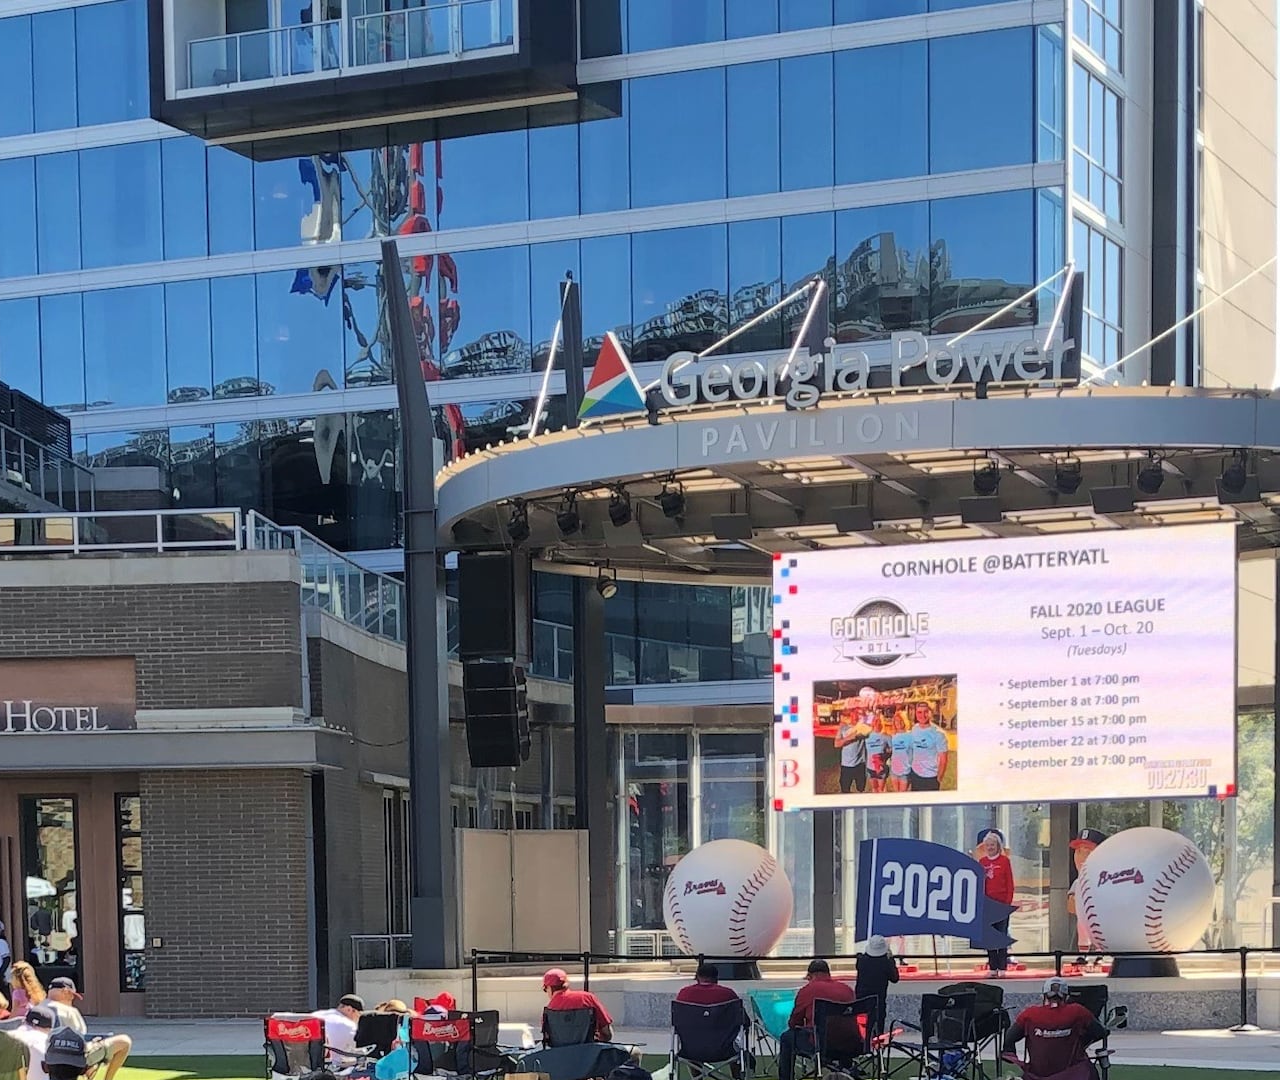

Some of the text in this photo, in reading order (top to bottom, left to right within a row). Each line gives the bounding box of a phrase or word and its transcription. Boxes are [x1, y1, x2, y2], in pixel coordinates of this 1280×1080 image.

[660, 331, 1076, 409] Georgia Power
[701, 411, 921, 457] PAVILION
[881, 548, 1110, 578] CORNHOLE @BATTERYATL
[1030, 598, 1166, 619] FALL 2020 LEAGUE
[830, 612, 930, 640] CORNHOLE
[1041, 625, 1075, 641] Sept.
[1080, 625, 1087, 637] 1
[1104, 622, 1132, 636] Oct.
[1136, 621, 1154, 634] 20
[1067, 642, 1128, 659] (Tuesdays)
[1008, 674, 1140, 691] September 1 at 7:00 pm
[1008, 694, 1140, 711] September 8 at 7:00 pm
[3, 700, 109, 732] HOTEL
[1008, 714, 1147, 731] September 15 at 7:00 pm
[1008, 734, 1147, 751] September 22 at 7:00 pm
[1008, 757, 1068, 770] September
[1071, 756, 1085, 766] 29
[1087, 755, 1099, 766] at
[1102, 754, 1126, 765] 7:00
[1128, 755, 1147, 766] pm
[1097, 867, 1135, 887] Braves
[683, 879, 719, 896] Braves
[879, 860, 978, 924] 2020
